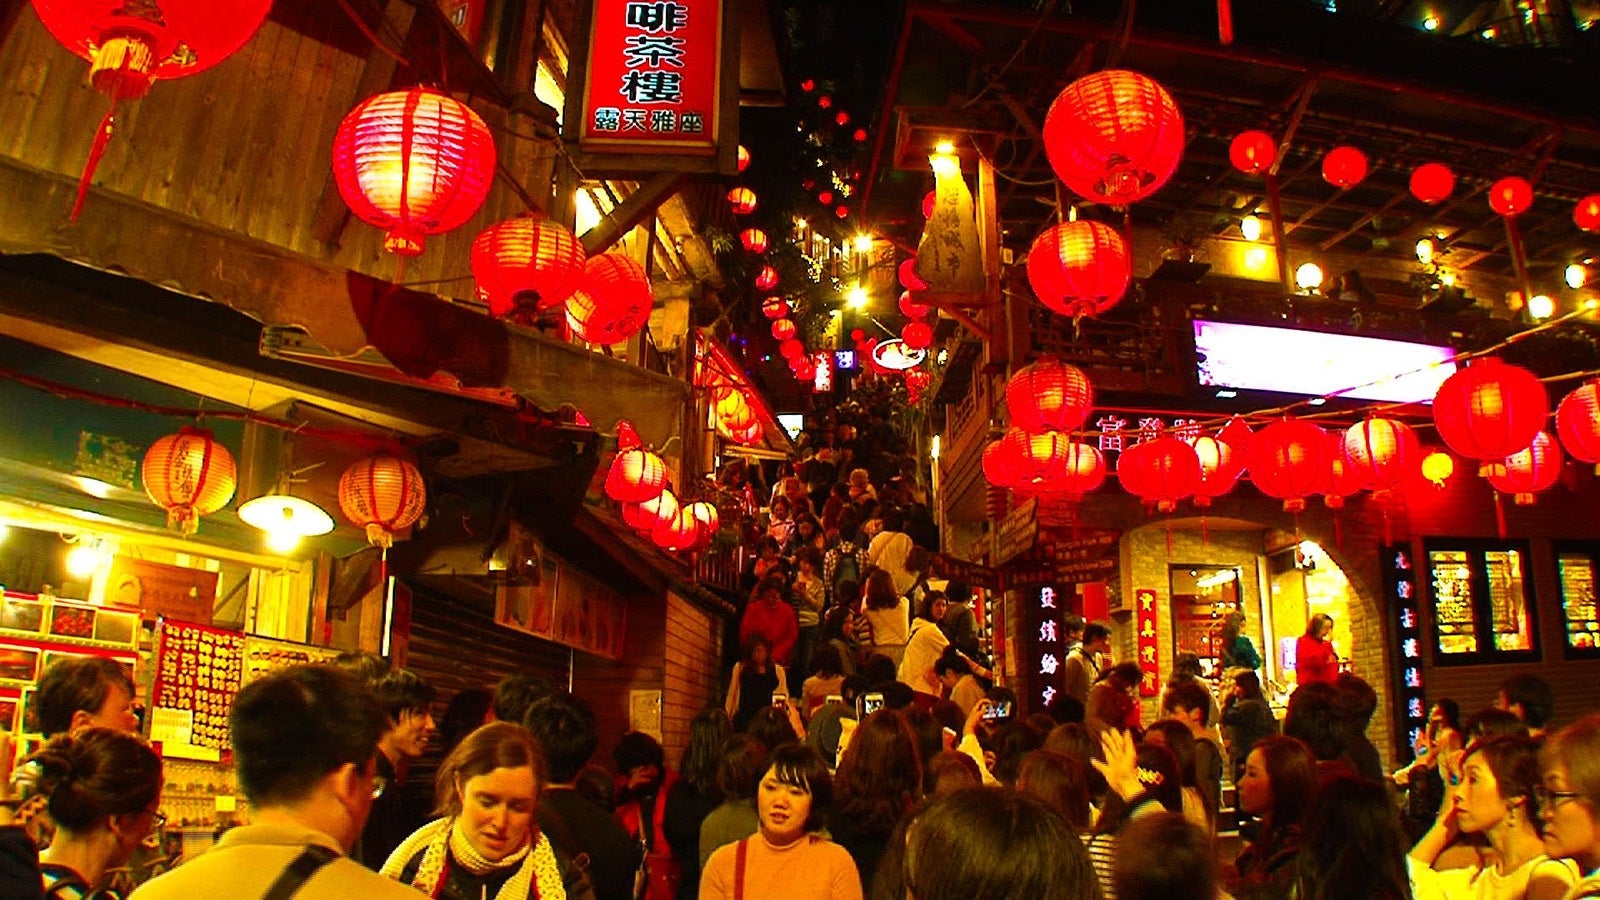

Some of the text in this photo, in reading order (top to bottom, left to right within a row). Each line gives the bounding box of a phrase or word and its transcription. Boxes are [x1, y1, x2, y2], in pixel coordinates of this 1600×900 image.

[620, 2, 688, 104] 啡茶樓
[594, 107, 703, 133] 露天雅座
